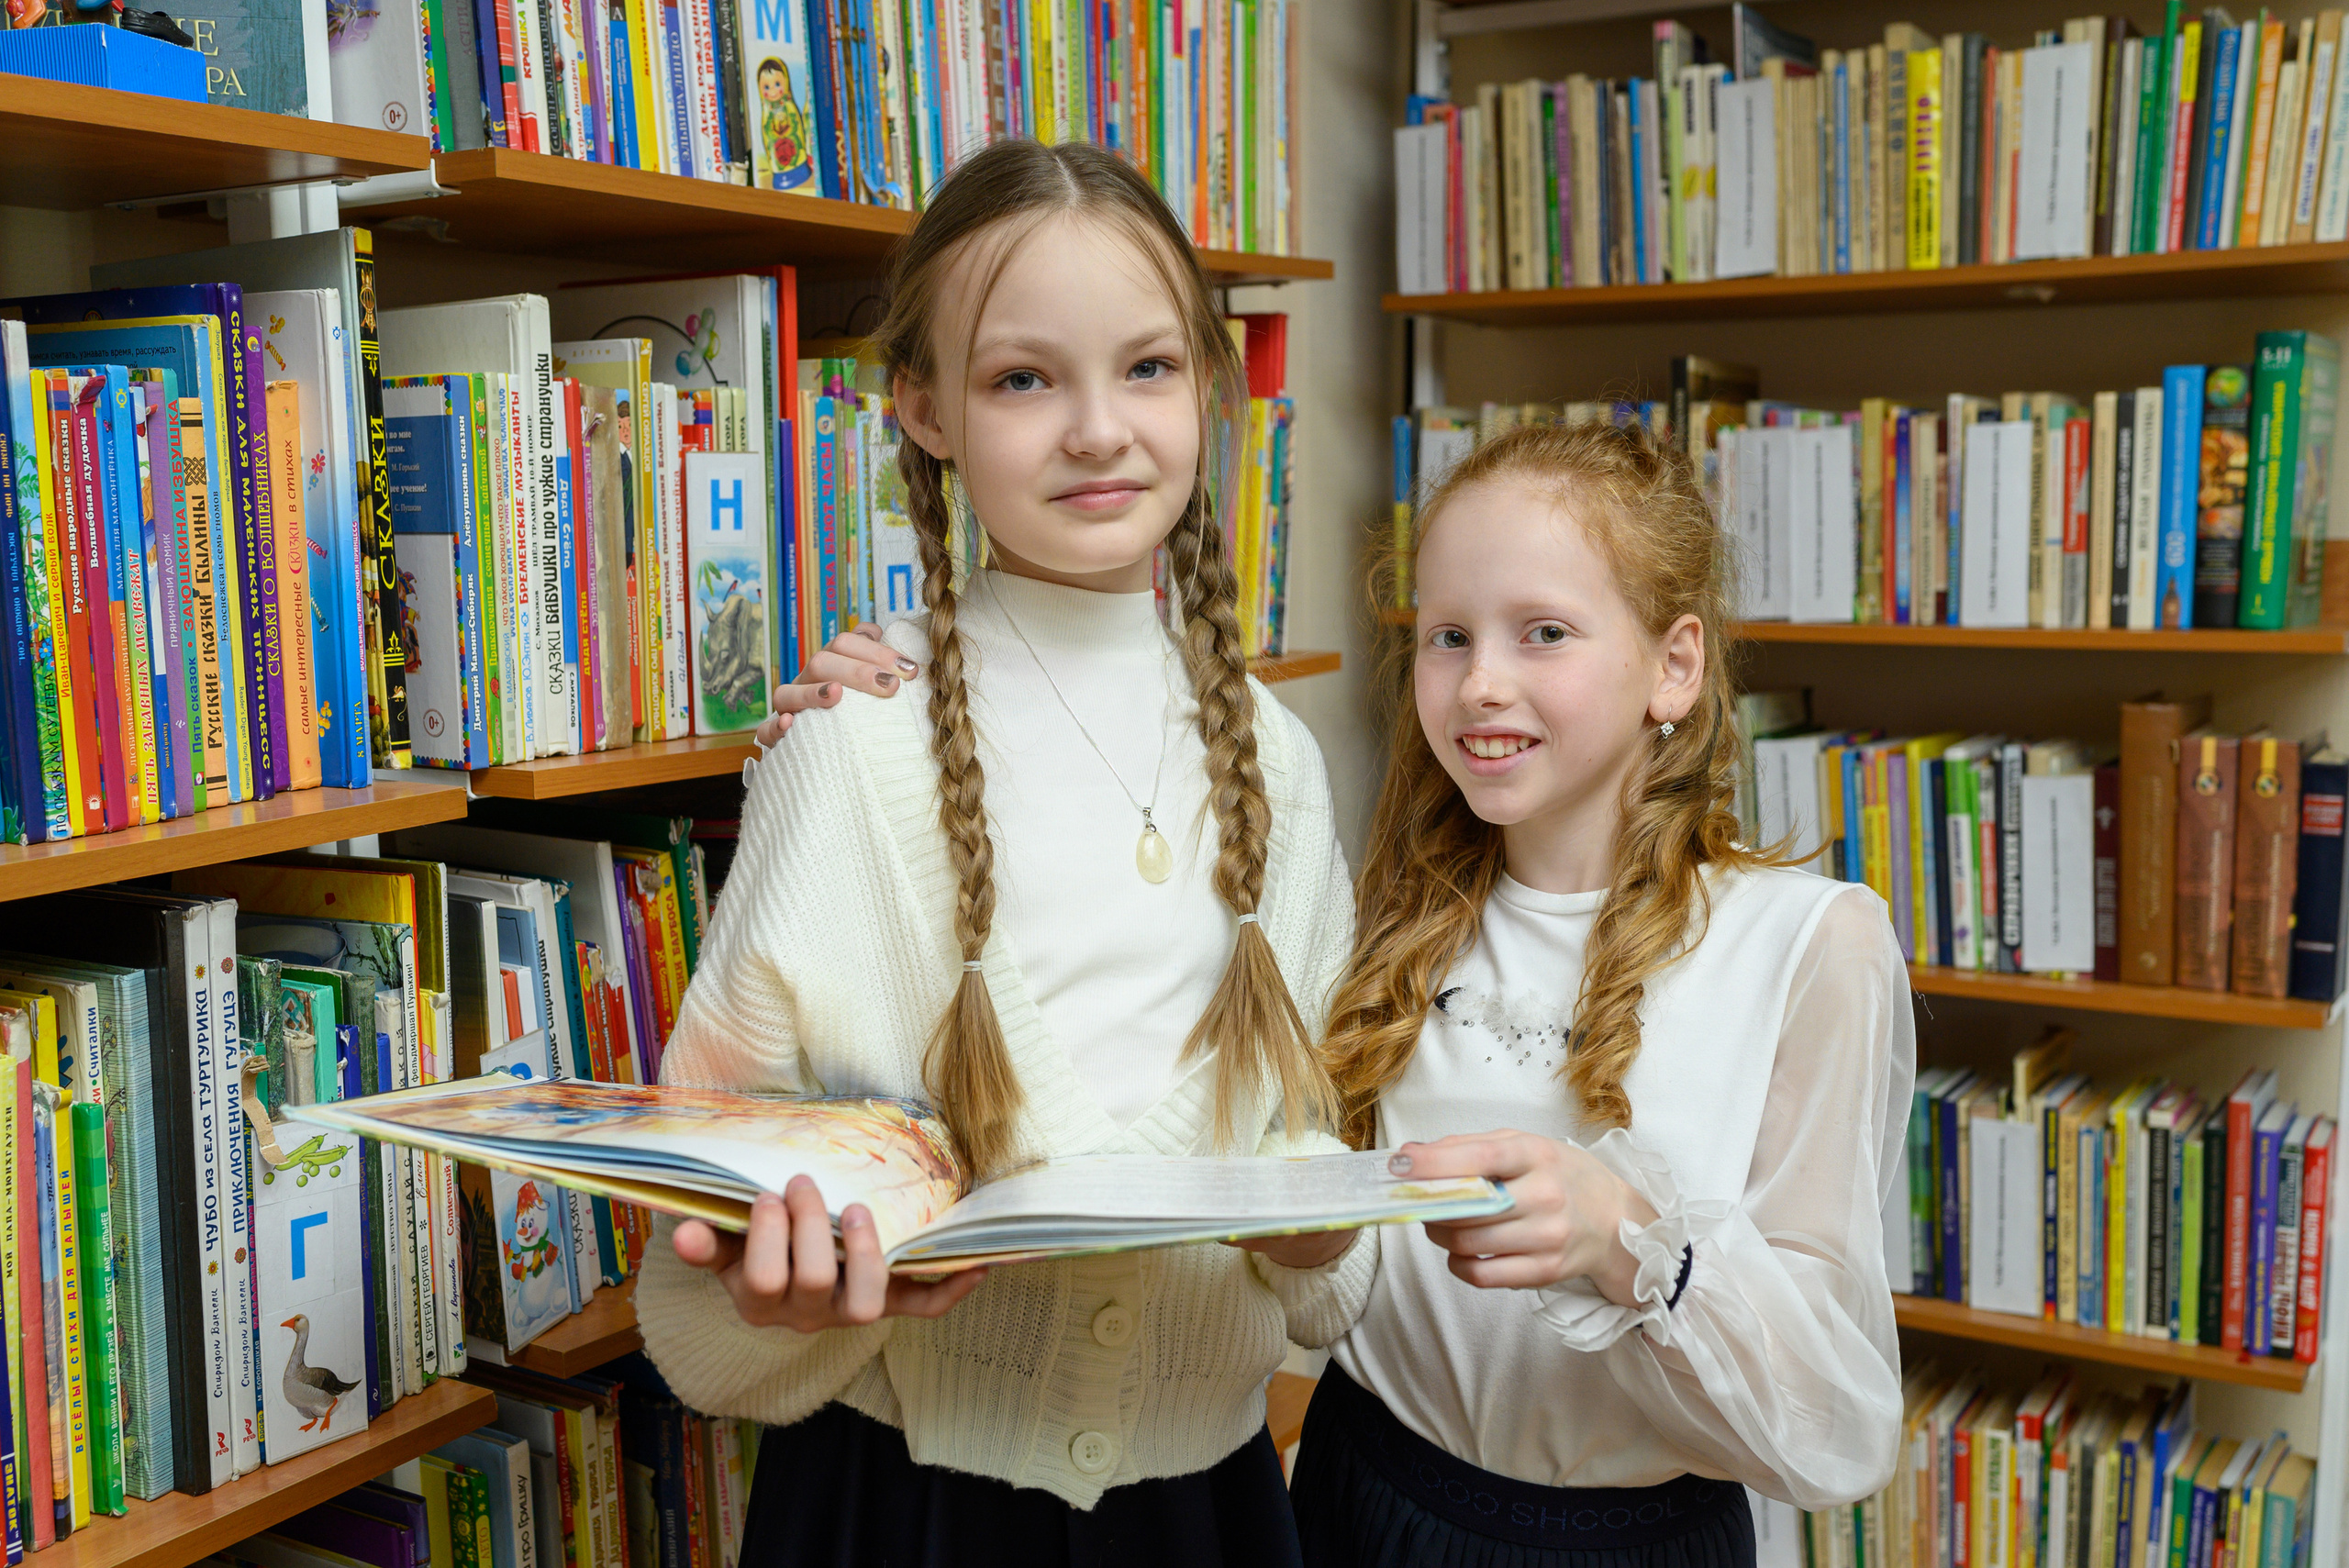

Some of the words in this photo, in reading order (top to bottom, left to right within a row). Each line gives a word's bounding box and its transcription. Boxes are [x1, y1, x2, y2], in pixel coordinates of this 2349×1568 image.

[517, 11, 532, 79] КРОШКА
[755, 0, 793, 44] М
[671, 31, 685, 90] ЛИНДО
[724, 38, 734, 63] Хью
[389, 109, 401, 124] 0+
[674, 93, 691, 162] ЭЛЬВИРА
[700, 93, 710, 138] ДЕНЬ
[707, 83, 723, 174] ЛЮБИМЫЕ
[50, 350, 78, 361] считать,
[79, 349, 109, 361] узнавать
[110, 348, 132, 358] время,
[135, 345, 176, 356] рассуждать
[230, 311, 245, 408] СКАЗКИ
[534, 353, 553, 449] странушки
[641, 382, 651, 417] СЕРГЕЙ
[59, 418, 71, 472] сказки
[78, 417, 93, 481] дудочка
[168, 400, 183, 503] ИЗБУШКА
[236, 416, 249, 468] ДЛЯ
[457, 415, 467, 460] сказки
[511, 391, 524, 492] МУЗЫКАНТЫ
[641, 419, 651, 473] ОБРАЗЦОВ
[657, 401, 665, 468] БАРАНКИНА
[107, 439, 119, 525] МАМОНТЁНКА
[284, 440, 296, 499] стихах
[401, 483, 428, 495] учение!
[478, 448, 489, 505] зайчиков
[539, 454, 556, 506] чужие
[820, 442, 833, 496] ЧАСЫ
[62, 476, 77, 550] народные
[212, 491, 221, 531] гномов
[253, 430, 273, 570] ВОЛШЕБНИКАХ
[287, 505, 296, 513] в
[369, 415, 397, 590] СКАЗКИ
[459, 463, 473, 547] Алёнушкины
[529, 485, 537, 538] ТРАМВАЙ
[543, 511, 557, 539] про
[559, 478, 569, 517] Дядя
[659, 474, 669, 554] ПРИКЛЮЧЕНИЯ
[710, 479, 742, 531] Н
[45, 513, 55, 543] волк
[83, 484, 99, 568] Волшебная
[162, 533, 175, 574] ДОМИК
[241, 478, 260, 618] МАЛЕНЬКИХ
[481, 513, 493, 578] солнечных
[499, 533, 507, 574] ХОРОШО
[516, 497, 529, 605] БРЕМЕНСКИЕ
[562, 523, 572, 569] Стёпа
[823, 502, 835, 555] БЬЮТ
[47, 549, 60, 588] серый
[70, 554, 83, 614] Русские
[116, 554, 125, 589] МАМА
[177, 505, 195, 632] ЗАЮШКИНА
[263, 577, 276, 595] О
[542, 545, 560, 624] БАБУШКИ
[646, 528, 655, 591] МАЛЕНЬКИЕ
[825, 562, 837, 612] ПОКА
[128, 548, 147, 652] МЕДВЕЖАТ
[164, 579, 178, 648] ПРЯНИЧНЫЙ
[217, 573, 228, 642] Белоснежка
[500, 577, 508, 606] ТАКОЕ
[589, 567, 598, 628] ПРИНЦЕСС
[887, 563, 913, 612] П
[264, 603, 281, 676] СКАЗКИ
[292, 582, 307, 681] интересные
[465, 573, 479, 673] Мамин-Сибиряк
[484, 585, 498, 666] Приключения
[535, 641, 540, 650] С.
[648, 594, 657, 647] РАССКАЗЫ
[52, 606, 71, 698] Иван-царевич
[119, 612, 133, 702] МУЛЬТФИЛЬМЫ
[548, 629, 563, 695] СКАЗКИ
[650, 649, 658, 670] ПРО
[43, 672, 57, 737] СУТЕЕВА
[137, 659, 155, 752] ЗАБАВНЫХ
[186, 657, 199, 712] сказок
[252, 628, 271, 769] ПРИНЦЕСС
[297, 685, 310, 735] самые
[470, 675, 483, 731] Дмитрий
[651, 672, 661, 731] ЖИВОТНЫХ
[127, 706, 138, 767] ЛЮБИМЫЕ
[190, 716, 202, 753] Пять
[353, 700, 364, 746] МАРТА
[50, 741, 65, 810] СКАЗКАМ
[145, 759, 159, 804] ПЯТЬ
[56, 815, 67, 833] ПО
[665, 893, 681, 955] БАРБОСА
[405, 962, 416, 1008] Пулькин!
[86, 1006, 102, 1079] Считалки
[221, 989, 240, 1071] ГУГУЦЭ
[407, 1011, 418, 1083] фельдмаршал
[226, 1083, 245, 1233] ПРИКЛЮЧЕНИЯ
[60, 1170, 73, 1258] МАЛЫШЕЙ
[203, 1194, 219, 1252] ЧУБО
[404, 1178, 417, 1253] СЛУЧАЙ
[443, 1165, 455, 1236] Солнечный
[100, 1212, 110, 1252] СИЛЬНЕЕ
[291, 1212, 328, 1280] Г
[387, 1208, 396, 1255] ДЕТСТВО
[5, 1262, 13, 1279] МОЙ
[65, 1268, 76, 1301] ДЛЯ
[103, 1256, 111, 1272] МЫ
[420, 1244, 432, 1299] ГЕОРГИЕВ
[104, 1275, 113, 1311] ВМЕСТЕ
[208, 1288, 220, 1335] Вангели
[236, 1278, 248, 1326] Вангели
[68, 1310, 79, 1364] СТИХИ
[106, 1331, 116, 1363] ДРУЗЕЙ
[423, 1301, 433, 1341] СЕРГЕЙ
[211, 1340, 226, 1399] Спиридон
[238, 1329, 252, 1387] Спиридон
[71, 1373, 83, 1454] ВЕСЁЛЫЕ
[109, 1401, 118, 1429] ВИННИ
[111, 1432, 120, 1465] ШКОЛА
[517, 1474, 530, 1529] Гришку
[1510, 1497, 1685, 1531] SHCOOL
[479, 1527, 491, 1559] ЛЕТО
[520, 1531, 532, 1562] про
